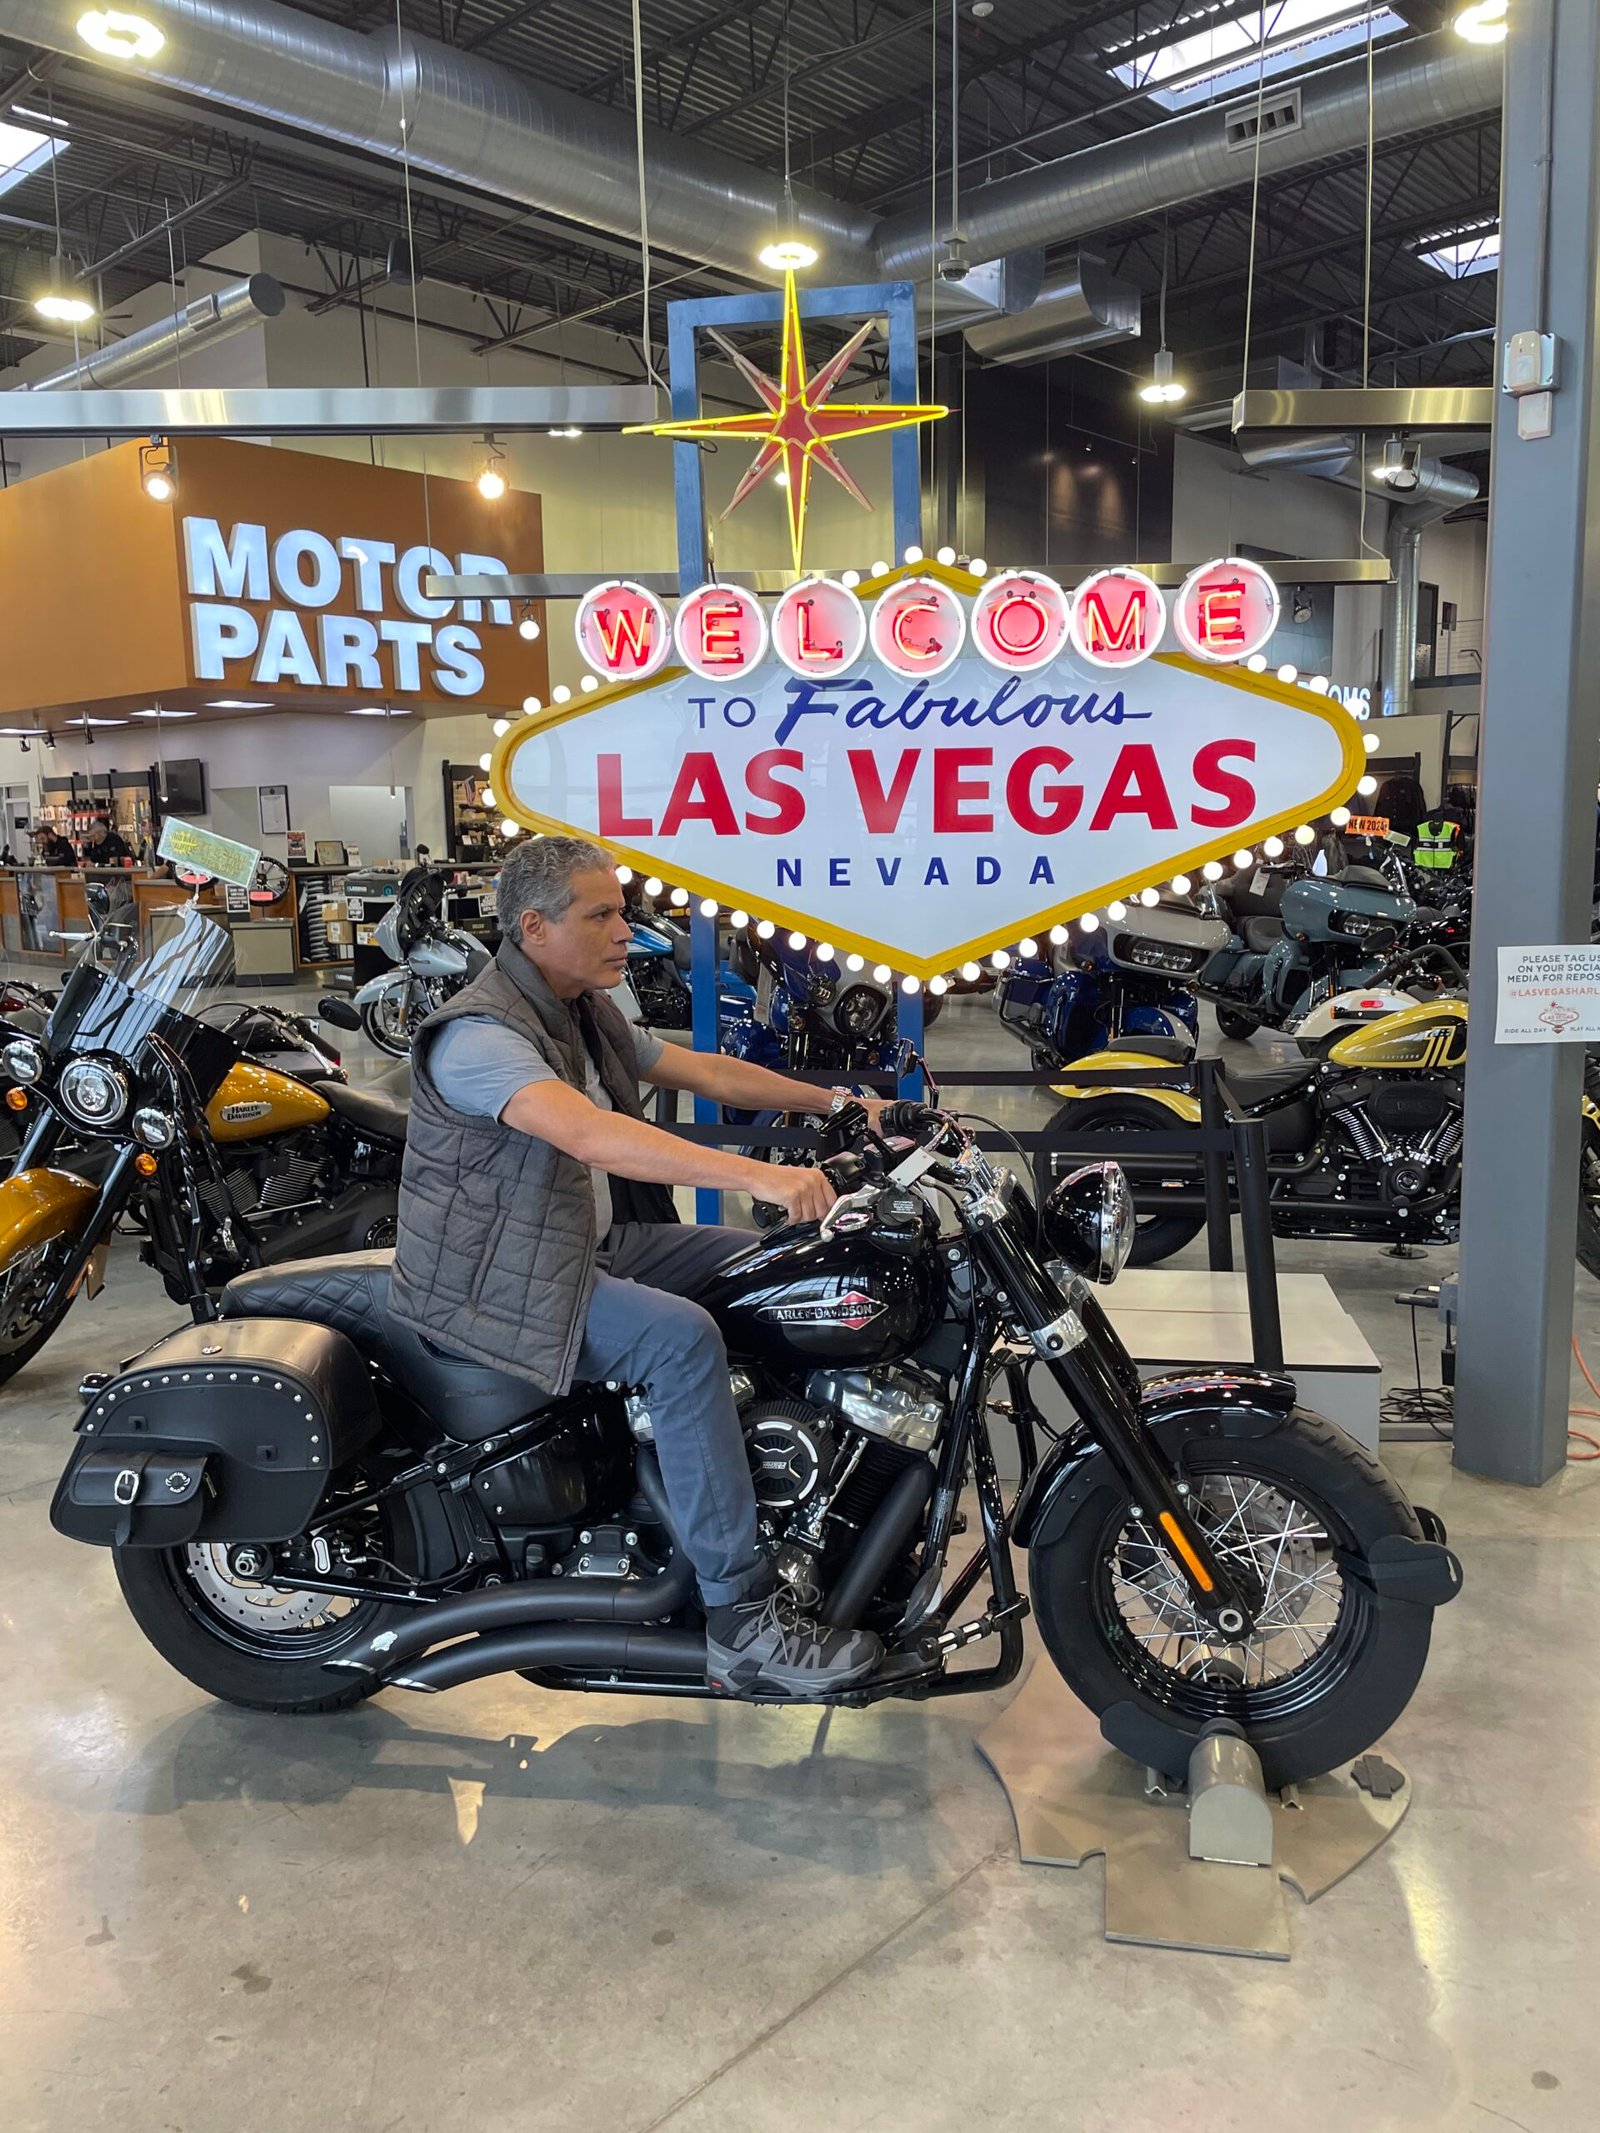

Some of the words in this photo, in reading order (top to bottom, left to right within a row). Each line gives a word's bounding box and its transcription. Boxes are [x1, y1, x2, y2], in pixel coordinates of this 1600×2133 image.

[182, 516, 514, 625] MOTOR
[592, 582, 1246, 668] WELCOME
[189, 602, 486, 697] PARTS
[687, 696, 757, 730] TO
[774, 675, 1153, 747] Fabulous
[596, 748, 807, 837] LAS
[846, 737, 1257, 836] VEGAS
[776, 855, 1056, 888] NEVADA
[1517, 965, 1533, 974] ON
[1536, 964, 1565, 973] YOUR
[1522, 954, 1561, 964] PLEASE
[1563, 954, 1586, 963] TAG
[1507, 974, 1540, 983] MEDIA
[1542, 973, 1564, 982] FOR
[227, 1111, 261, 1121] DAVIDSON
[768, 1303, 873, 1321] HARLEY-DAVIDSON
